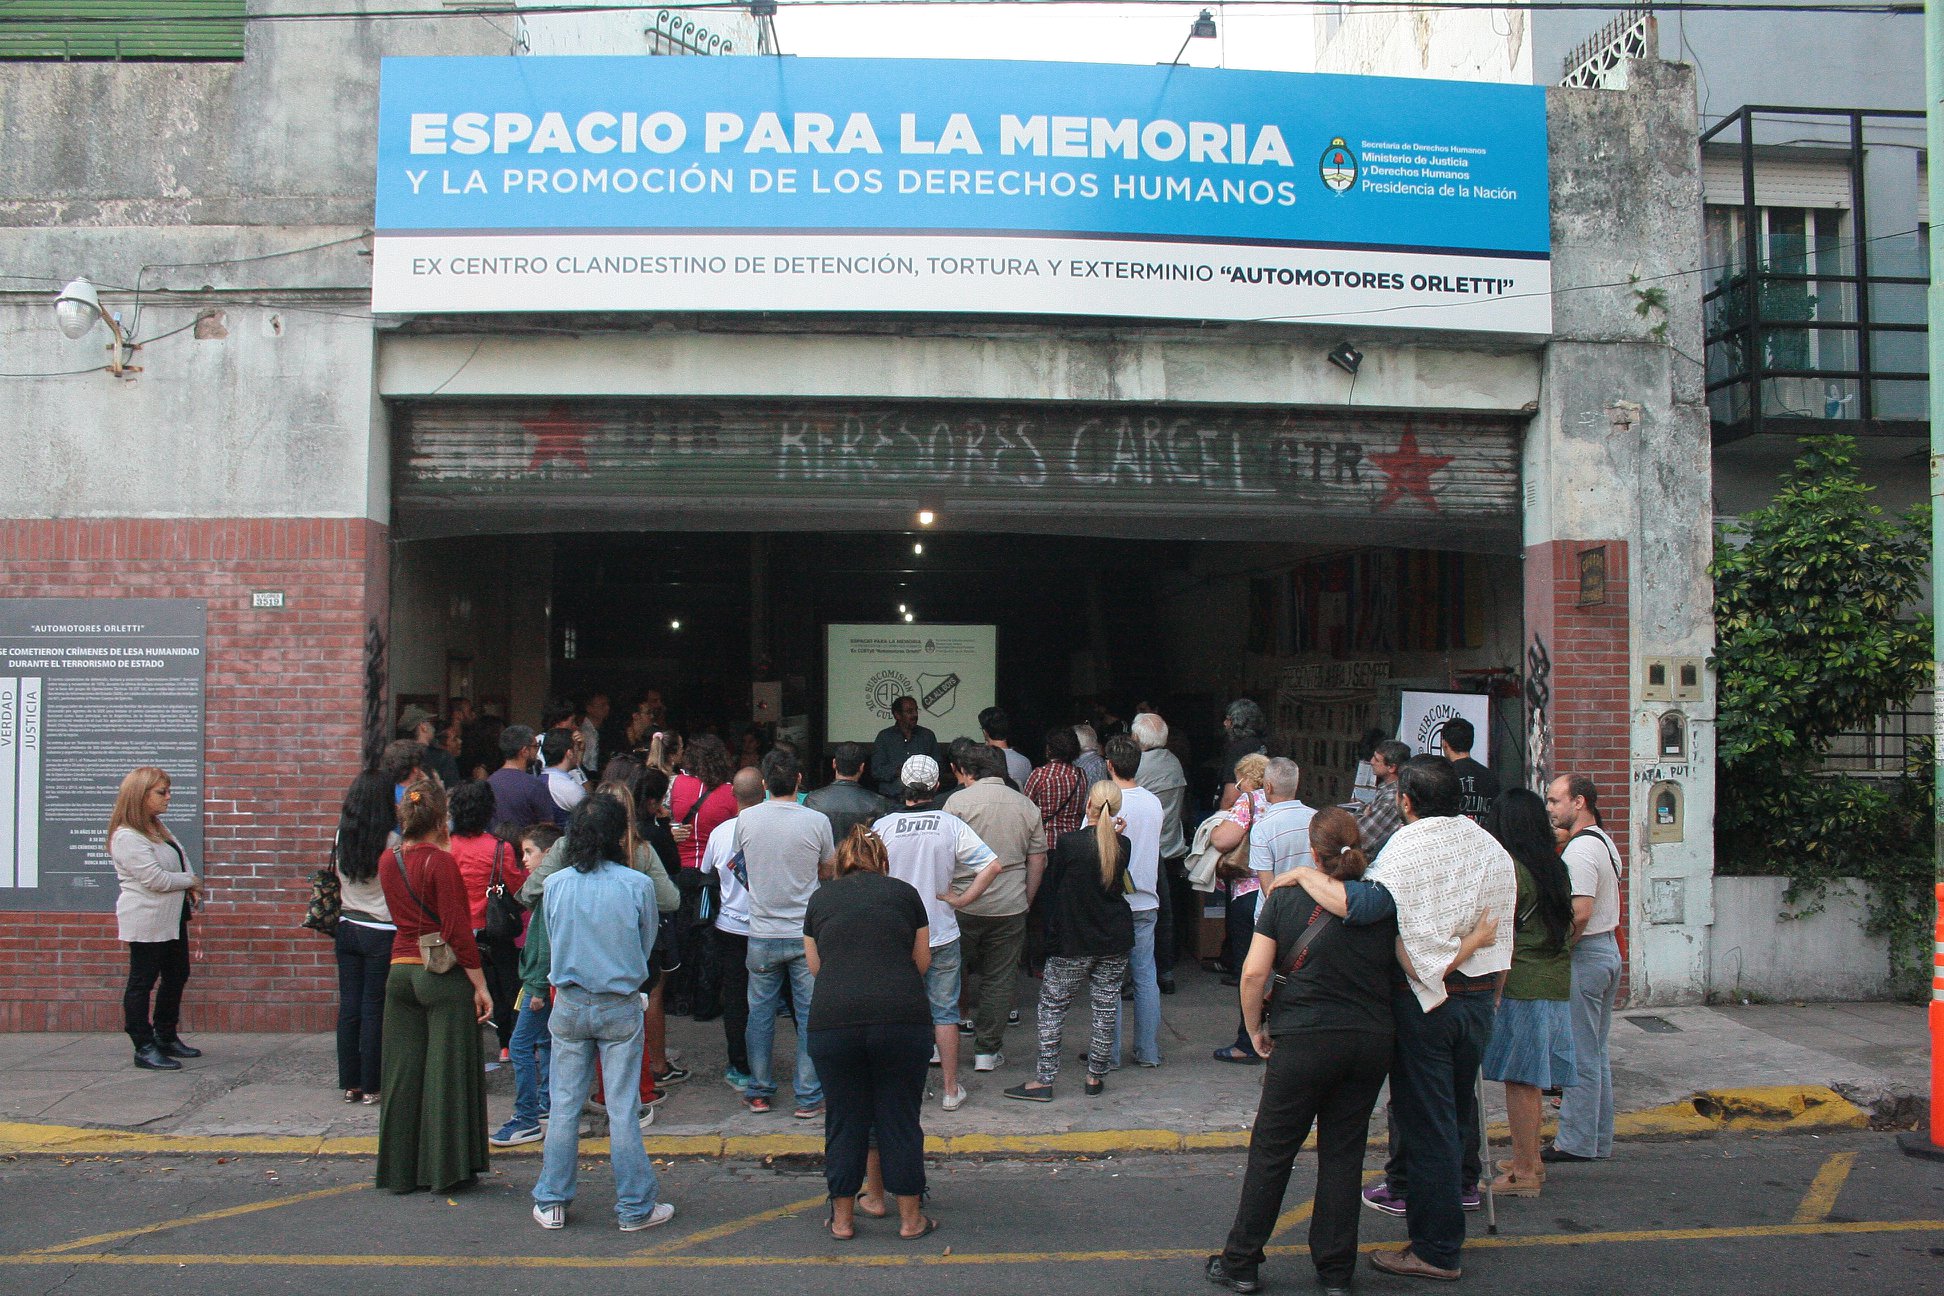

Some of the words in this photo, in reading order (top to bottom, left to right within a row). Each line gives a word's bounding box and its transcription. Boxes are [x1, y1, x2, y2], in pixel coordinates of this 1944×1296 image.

[410, 112, 687, 154] ESPACIO
[705, 112, 883, 154] PARA
[900, 112, 983, 155] LA
[1000, 114, 1294, 167] MEMORIA
[1361, 140, 1400, 150] Secretaría
[1401, 142, 1411, 151] de
[1412, 143, 1449, 153] Derechos
[1450, 145, 1487, 155] Humanos
[1362, 152, 1412, 164] Ministerio
[1415, 154, 1427, 165] de
[1429, 156, 1468, 167] Justicia
[1362, 168, 1368, 176] y
[1370, 166, 1419, 177] Derechos
[1421, 168, 1470, 180] Humanos
[406, 169, 428, 194] Y
[443, 169, 487, 194] LA
[503, 162, 733, 194] PROMOCIÓN
[750, 168, 797, 193] DE
[812, 168, 883, 194] LOS
[900, 168, 1098, 198] DERECHOS
[1114, 174, 1296, 206] HUMANOS
[1362, 181, 1435, 196] Presidencia
[1439, 183, 1455, 197] de
[1458, 184, 1470, 198] la
[1473, 186, 1517, 200] Nación
[412, 258, 442, 275] EX
[450, 256, 548, 275] CENTRO
[556, 255, 727, 274] CLANDESTINO
[734, 256, 766, 274] DE
[774, 253, 919, 278] DETENCIÓN,
[927, 256, 1040, 276] TORTURA
[1045, 258, 1062, 276] Y
[1070, 260, 1213, 282] EXTERMINIO
[1220, 265, 1404, 290] “AUTOMOTORES
[1410, 274, 1515, 295] ORLETTI”
[31, 624, 102, 633] “AUTOMOTORES
[104, 624, 145, 633] ORLETTI”
[9, 647, 65, 656] COMETIERON
[66, 645, 108, 656] CRÍMENES
[110, 647, 122, 656] DE
[123, 647, 143, 656] LESA
[145, 648, 200, 656] HUMANIDAD
[8, 659, 49, 668] DURANTE
[51, 659, 61, 668] EL
[62, 659, 116, 668] TERRORISMO
[118, 659, 130, 668] DE
[131, 659, 164, 668] ESTADO
[1, 690, 13, 747] VERDAD
[25, 691, 37, 750] JUSTICIA
[1417, 703, 1462, 743] SUBCOMIS
[895, 815, 941, 834] Bruni
